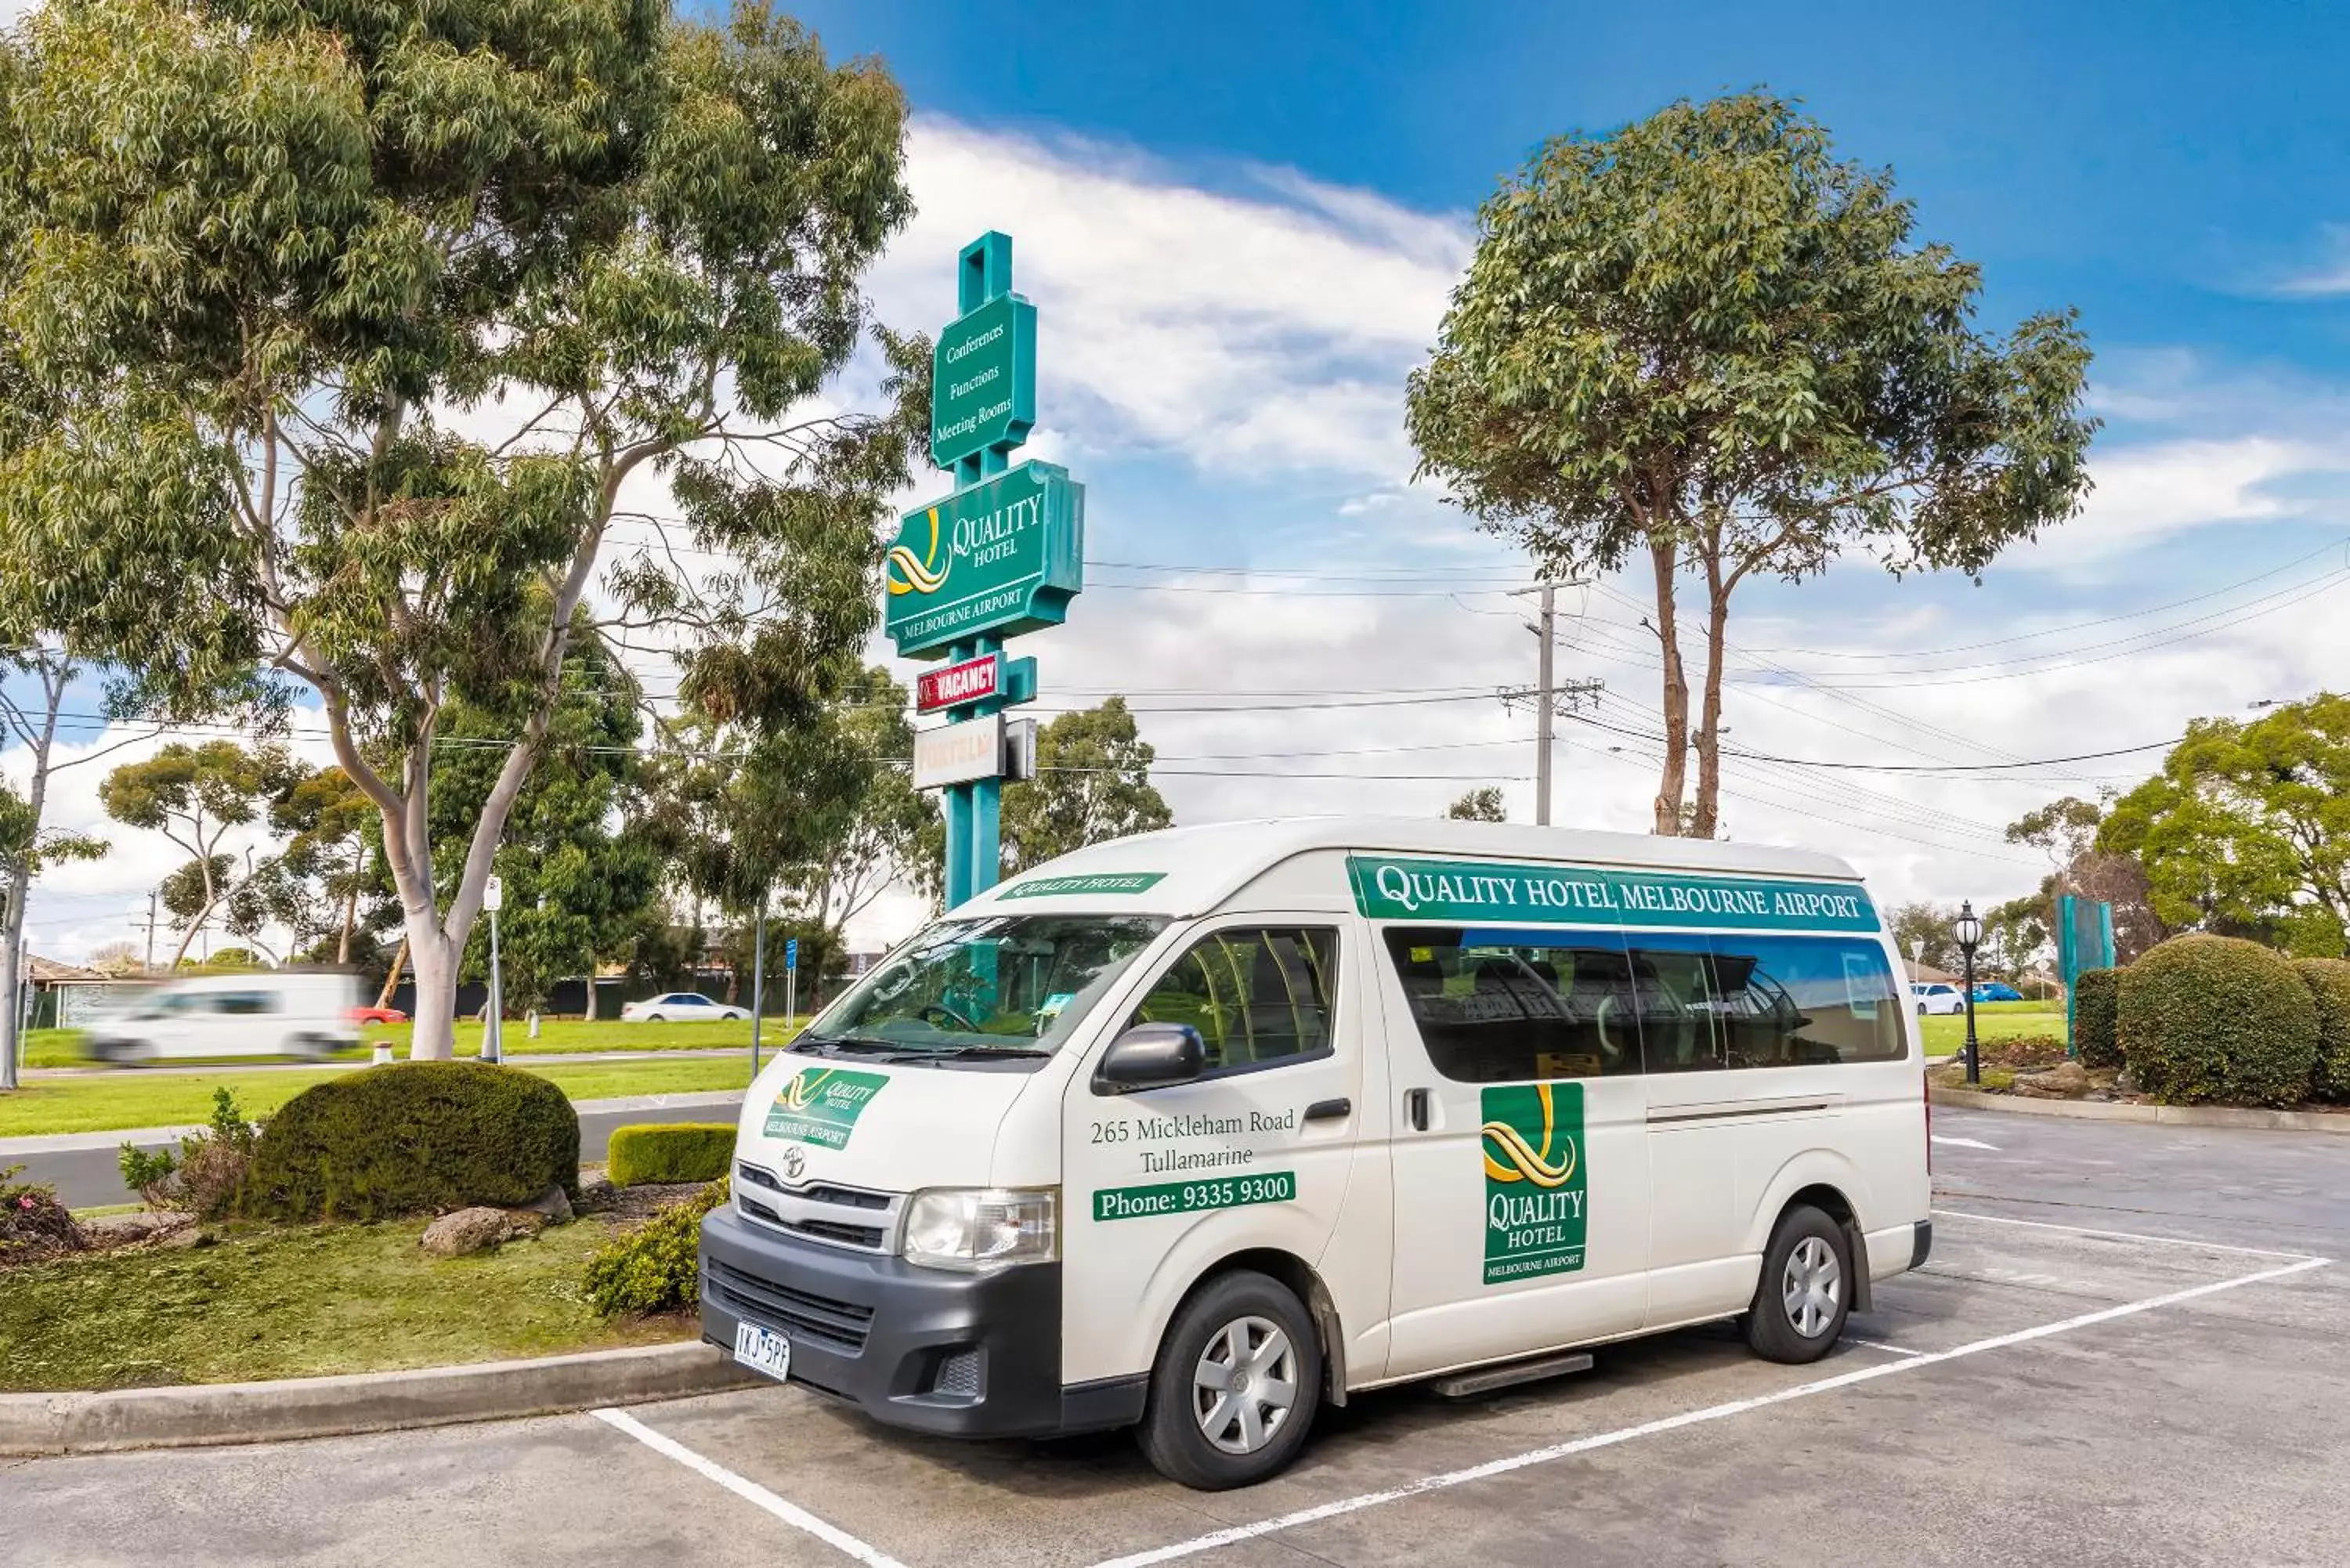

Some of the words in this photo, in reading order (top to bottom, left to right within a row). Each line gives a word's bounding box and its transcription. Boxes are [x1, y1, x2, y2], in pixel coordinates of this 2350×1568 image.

[946, 323, 1004, 363] Conferences
[950, 365, 1000, 399] Functions
[936, 415, 977, 444] Meeting
[978, 398, 1012, 425] Rooms
[953, 493, 1043, 557] QUALITY
[974, 538, 1018, 568] HOTEL
[904, 605, 971, 639] MELBOURNE
[972, 588, 1024, 618] AIRPORT
[937, 662, 995, 701] VACANCY
[1014, 878, 1086, 897] QUALITY
[1086, 876, 1144, 889] HOTEL
[1376, 865, 1517, 911] QUALITY
[1524, 879, 1618, 909] HOTEL
[1620, 883, 1770, 915] MELBOURNE
[1774, 892, 1861, 918] AIRPORT
[825, 1097, 853, 1110] HOTEL
[826, 1080, 876, 1100] QUALITY
[767, 1120, 808, 1137] MELBOURNE
[808, 1126, 847, 1144] AIRPORT
[1090, 1120, 1129, 1144] 265
[1136, 1114, 1242, 1141] Mickleham
[1250, 1109, 1293, 1133] Road
[1140, 1146, 1253, 1173] Tullamarine
[1101, 1191, 1176, 1216] Phone:
[1183, 1183, 1233, 1209] 9335
[1240, 1177, 1289, 1201] 9300
[1489, 1190, 1584, 1232] QUALITY
[1507, 1225, 1566, 1248] HOTEL
[1488, 1259, 1542, 1277] MELBOURNE
[1544, 1253, 1582, 1270] AIRPORT
